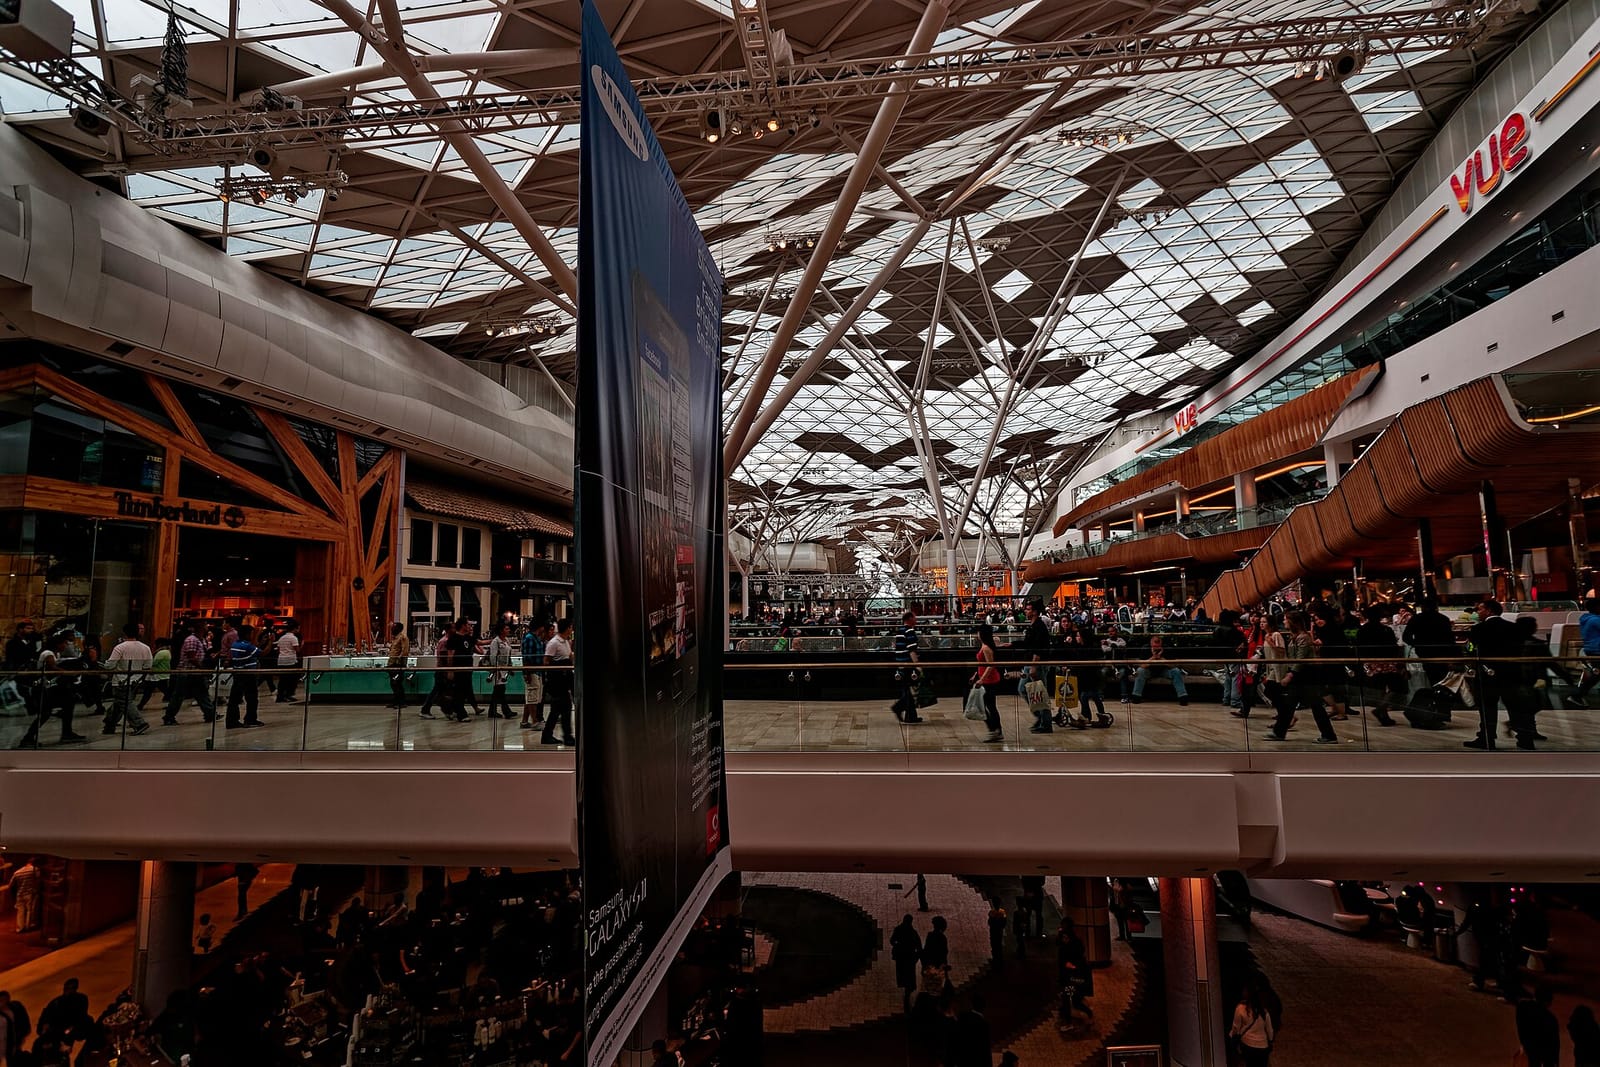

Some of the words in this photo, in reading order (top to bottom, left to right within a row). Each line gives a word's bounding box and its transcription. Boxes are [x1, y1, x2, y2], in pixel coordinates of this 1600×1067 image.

[600, 70, 645, 160] SAMSUNG
[114, 491, 221, 525] Timberland
[589, 887, 624, 928] Samsung
[589, 893, 633, 957] GALAXY
